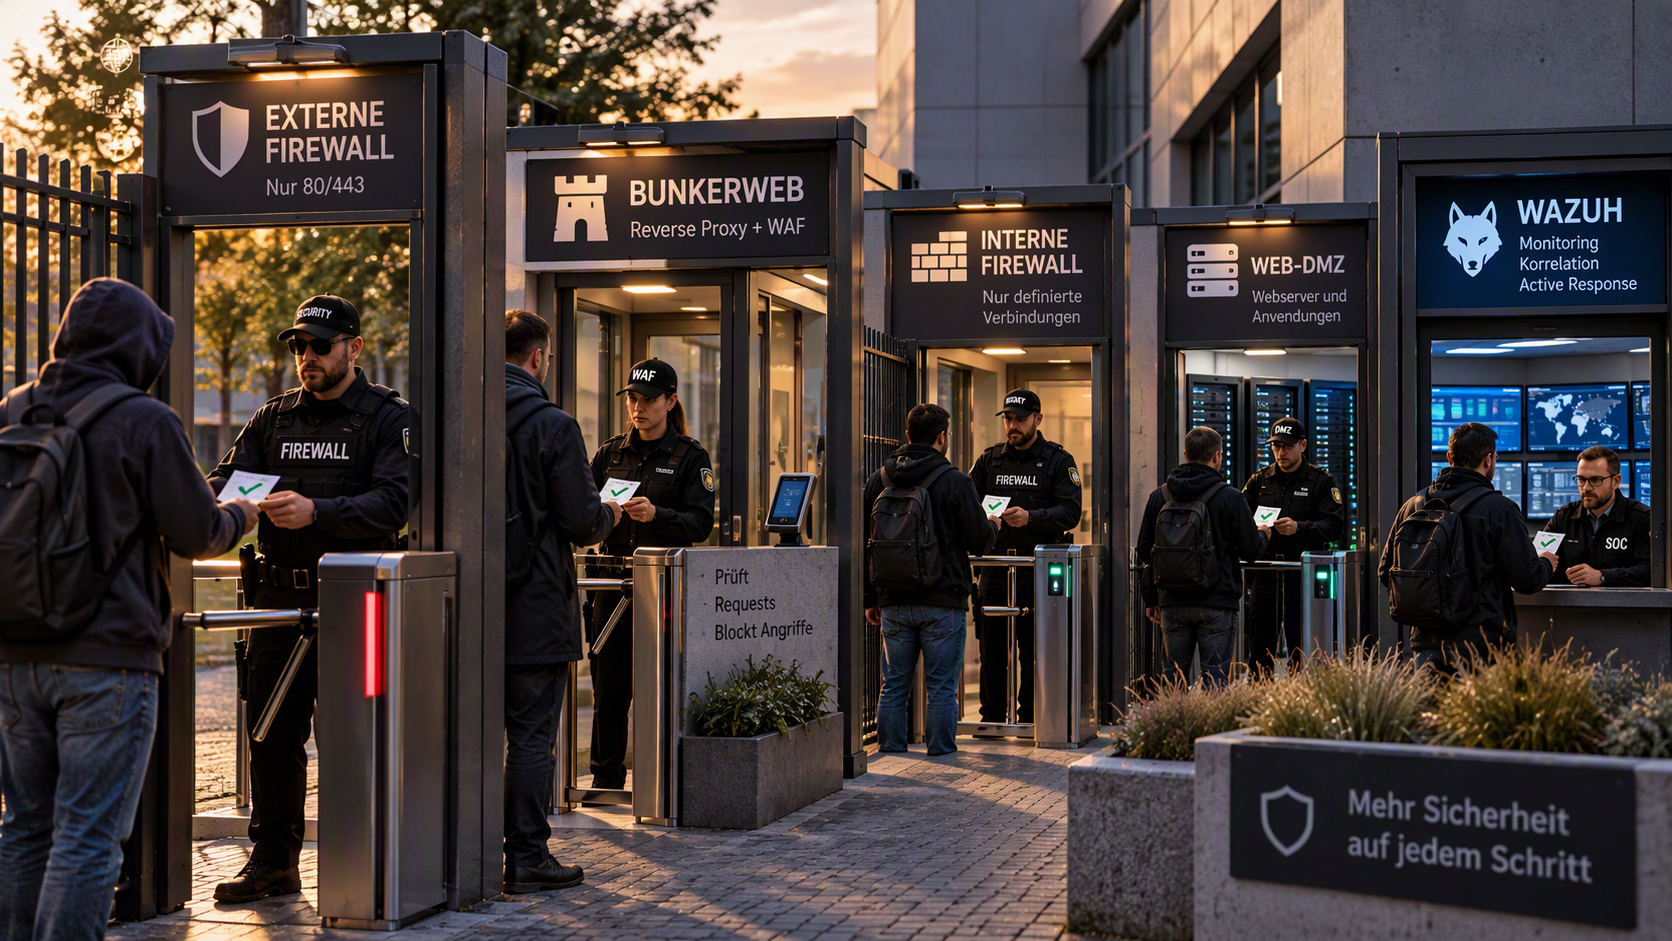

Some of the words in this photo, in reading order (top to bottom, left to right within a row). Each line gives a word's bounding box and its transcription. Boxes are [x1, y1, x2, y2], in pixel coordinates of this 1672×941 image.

[266, 100, 384, 131] EXTERNE
[266, 134, 395, 163] FIREWALL
[266, 178, 298, 196] Nur
[303, 175, 365, 196] 80/443
[630, 175, 805, 206] BUNKERWEB
[1517, 197, 1623, 224] WAZUH
[630, 220, 696, 239] Reverse
[701, 219, 748, 241] Proxy
[767, 217, 806, 235] WAF
[981, 228, 1068, 250] INTERNE
[1520, 235, 1599, 253] Monitoring
[981, 254, 1083, 275] FIREWALL
[1251, 254, 1345, 275] WEB-DMZ
[1520, 256, 1599, 271] Korrelation
[1519, 277, 1564, 292] Active
[1568, 276, 1638, 295] Response
[983, 289, 1009, 304] Nur
[1013, 289, 1083, 304] definierte
[1252, 289, 1320, 304] Webserver
[1323, 288, 1347, 303] und
[983, 309, 1081, 328] Verbindungen
[632, 369, 656, 382] WAF
[1274, 425, 1293, 435] DMZ
[280, 442, 350, 460] FIREWALL
[995, 474, 1038, 486] FIREWALL
[1605, 537, 1628, 550] SOC
[715, 568, 749, 585] Prüft
[715, 596, 776, 615] Requests
[715, 623, 757, 641] Blockt
[760, 619, 813, 641] Angriffe
[1348, 788, 1416, 821] Mehr
[1423, 794, 1570, 837] Sicherheit
[1347, 831, 1391, 860] auf
[1394, 833, 1482, 871] jedem
[1490, 844, 1593, 884] Schritt
